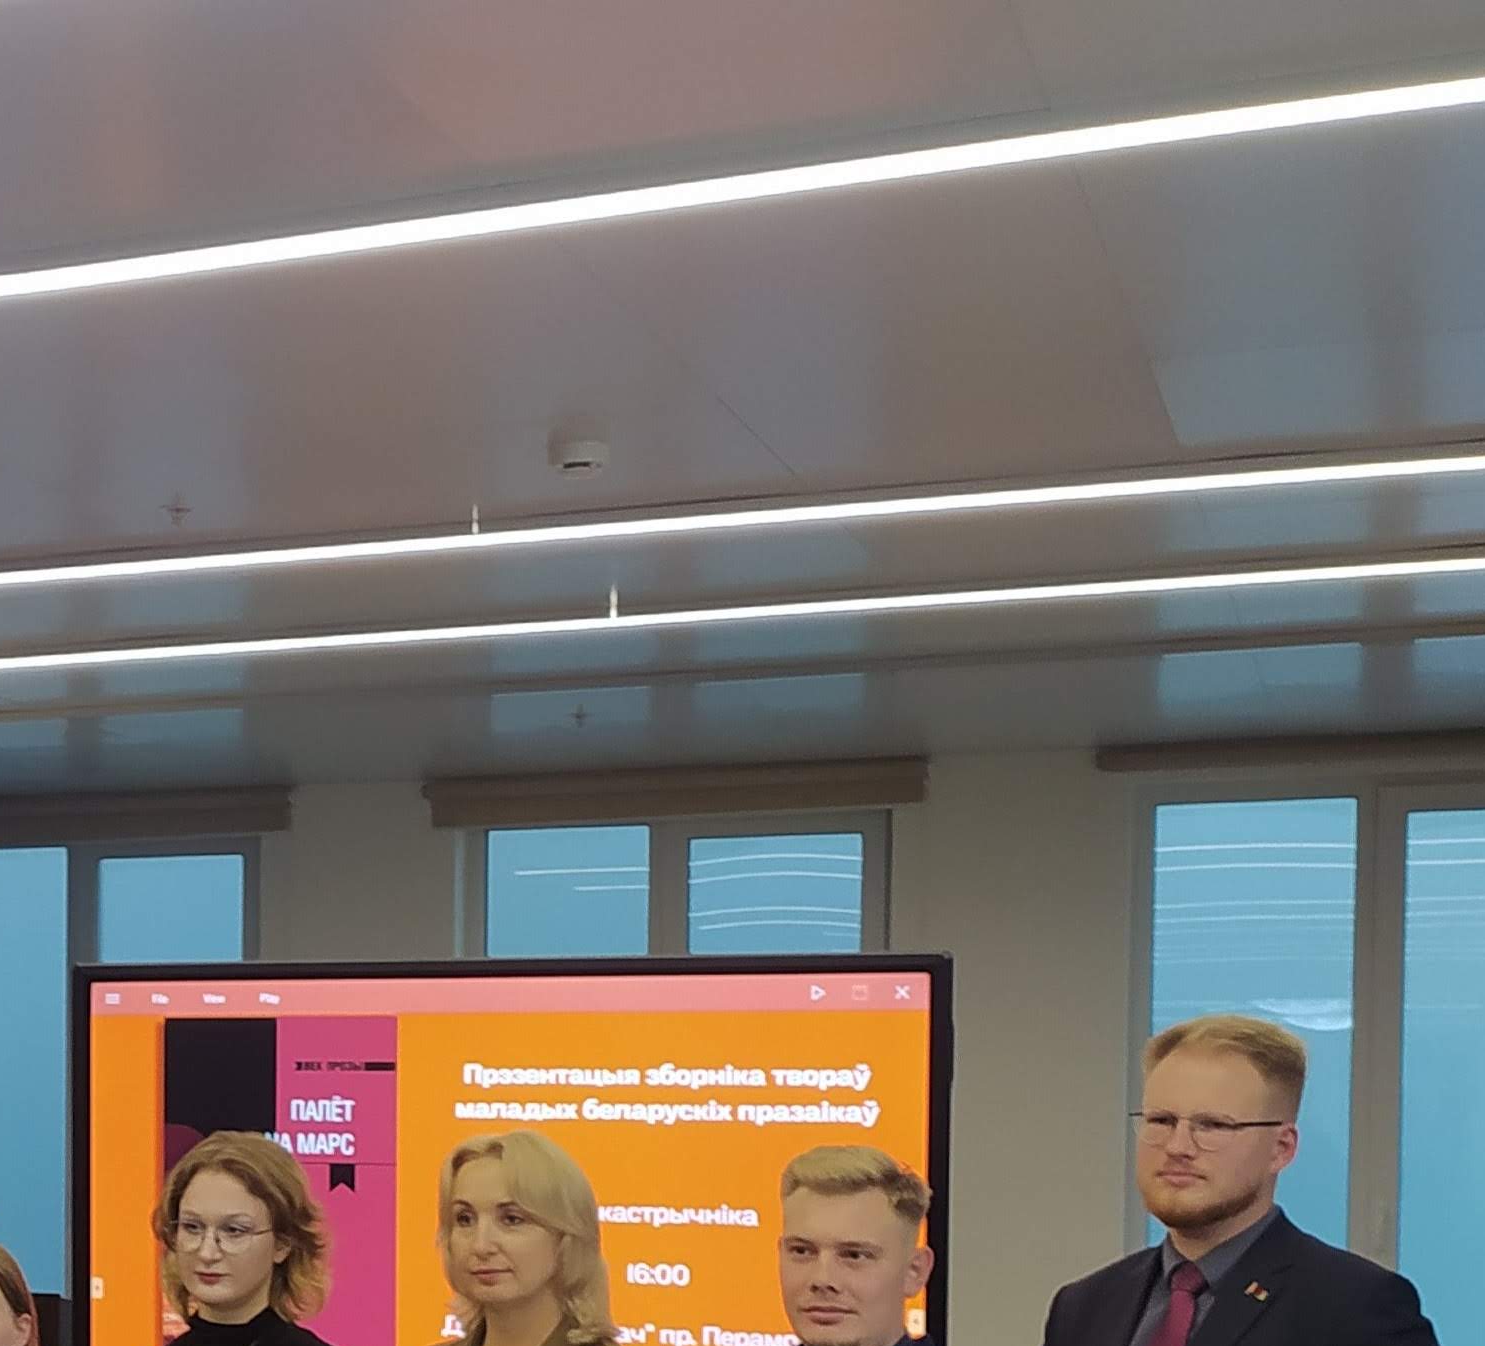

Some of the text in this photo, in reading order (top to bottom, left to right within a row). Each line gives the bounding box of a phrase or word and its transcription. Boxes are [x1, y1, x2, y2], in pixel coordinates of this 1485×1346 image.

[645, 1062, 767, 1090] зборніка
[771, 1063, 872, 1092] твораў
[290, 1095, 356, 1122] ПАЛЁТ
[455, 1098, 881, 1127] маладых беларускіх празаікаў
[296, 1132, 356, 1156] МАРС
[598, 1203, 759, 1228] кастрычніка
[627, 1262, 691, 1287] 16:00
